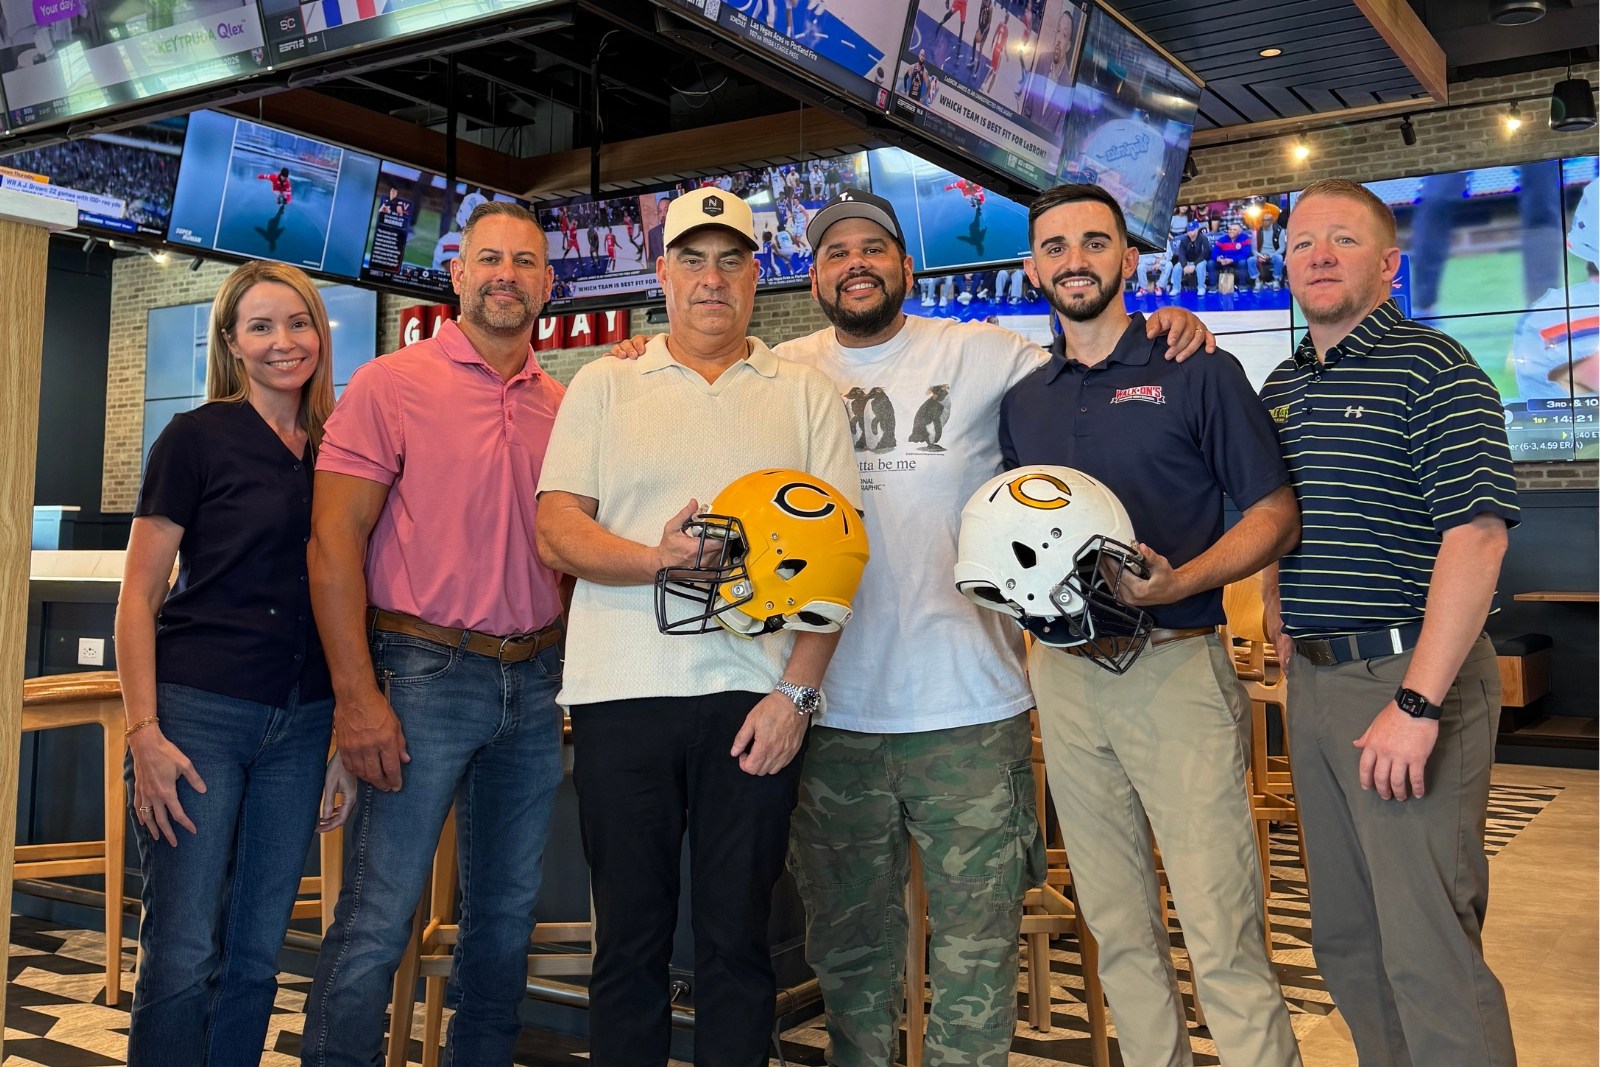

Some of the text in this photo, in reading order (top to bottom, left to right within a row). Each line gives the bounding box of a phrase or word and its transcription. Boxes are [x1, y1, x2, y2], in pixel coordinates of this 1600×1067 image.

[40, 4, 58, 16] Your
[280, 17, 296, 31] SC
[157, 28, 217, 54] KEYTRUDA
[279, 39, 305, 53] ESPN2
[750, 19, 759, 30] Las
[760, 24, 773, 38] Vegas
[773, 32, 785, 44] Aces
[790, 41, 809, 57] Portland
[808, 49, 818, 61] Fire
[940, 94, 962, 114] WHICH
[963, 104, 980, 122] TEAM
[980, 115, 987, 127] IS
[986, 120, 1002, 136] BEST
[1002, 128, 1012, 141] FIT
[1011, 133, 1023, 147] FOR
[1023, 140, 1047, 159] LeBRON?
[6, 178, 16, 186] WR
[49, 187, 57, 195] 22
[57, 190, 75, 199] games
[708, 198, 717, 207] N
[598, 283, 613, 291] TEAM
[538, 310, 617, 341] DAY
[1546, 398, 1599, 408] 3RD & 10
[1552, 414, 1593, 424] 14:21
[1520, 442, 1539, 452] (6-3,
[1540, 442, 1558, 450] 4.59
[858, 459, 917, 471] tta be me
[1006, 473, 1072, 510] C
[770, 481, 837, 520] C
